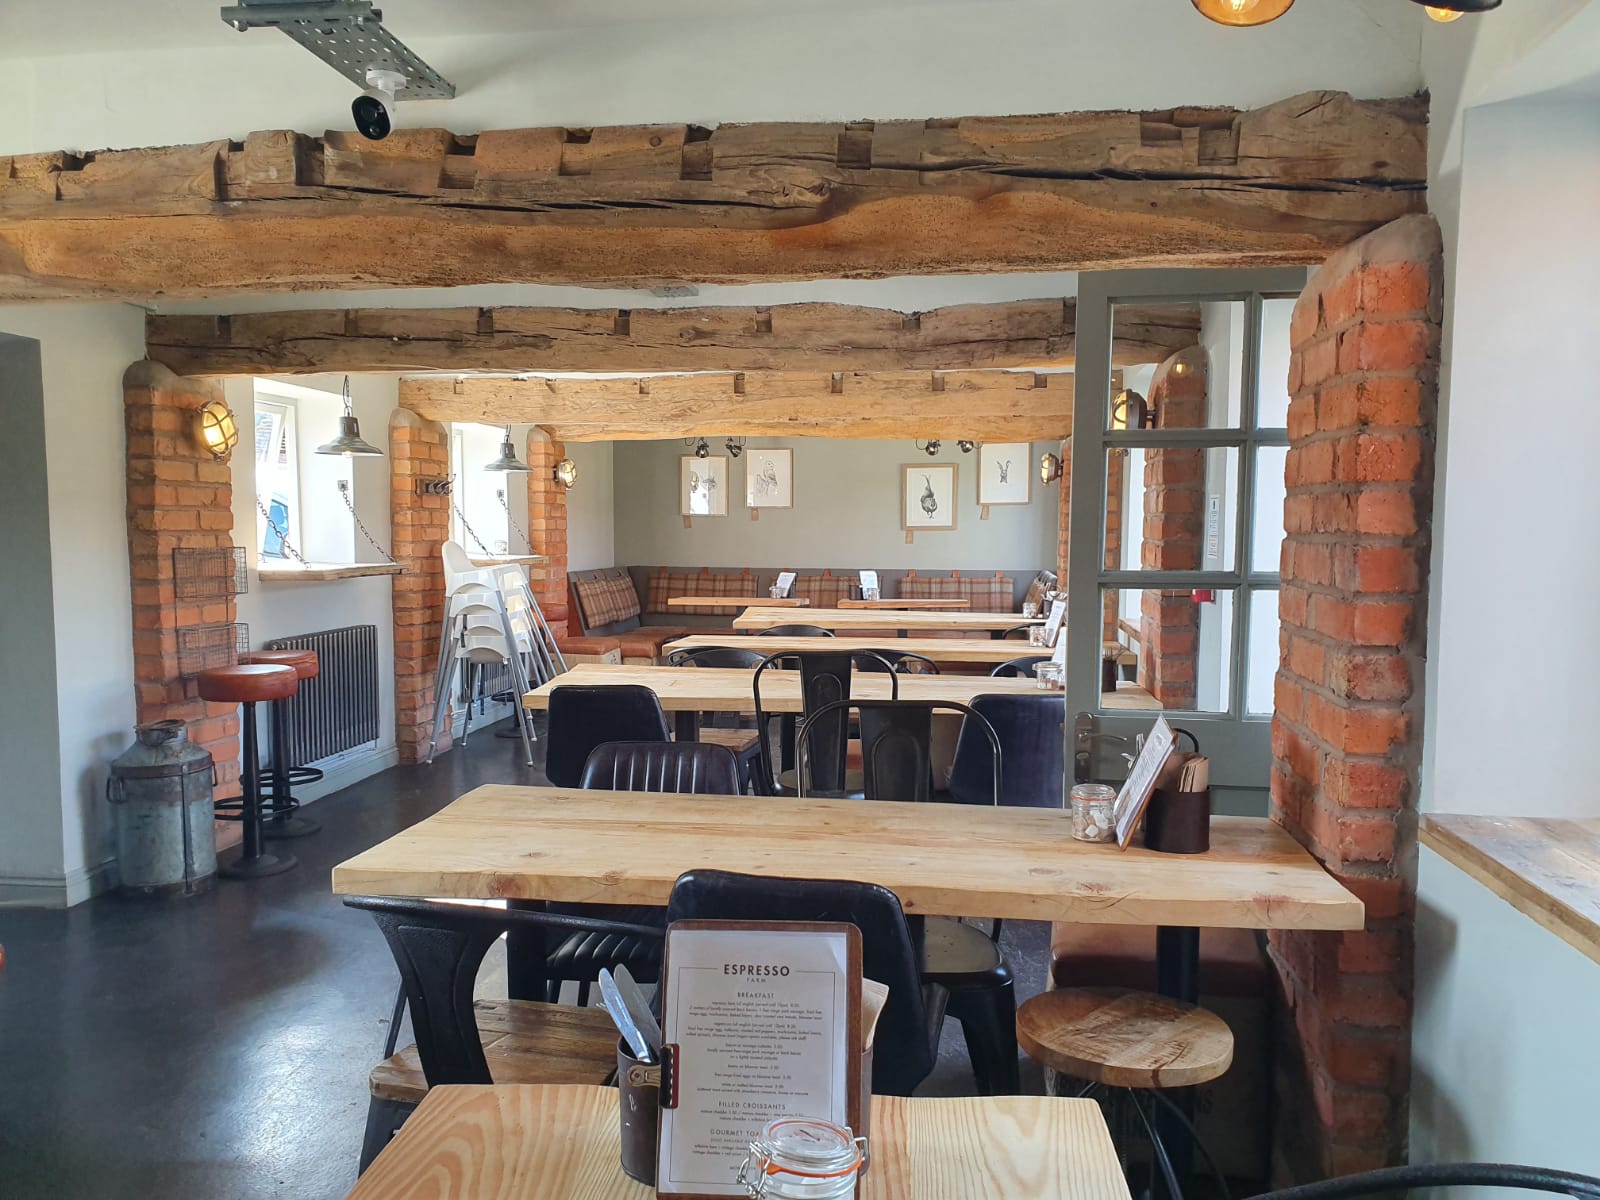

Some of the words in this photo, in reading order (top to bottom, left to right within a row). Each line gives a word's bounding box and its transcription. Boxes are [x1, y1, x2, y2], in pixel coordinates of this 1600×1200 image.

[724, 964, 790, 977] ESPRESSO
[737, 991, 774, 999] BREAKFAST
[742, 1102, 786, 1110] CROISSANTS
[710, 1128, 743, 1137] GOURMET
